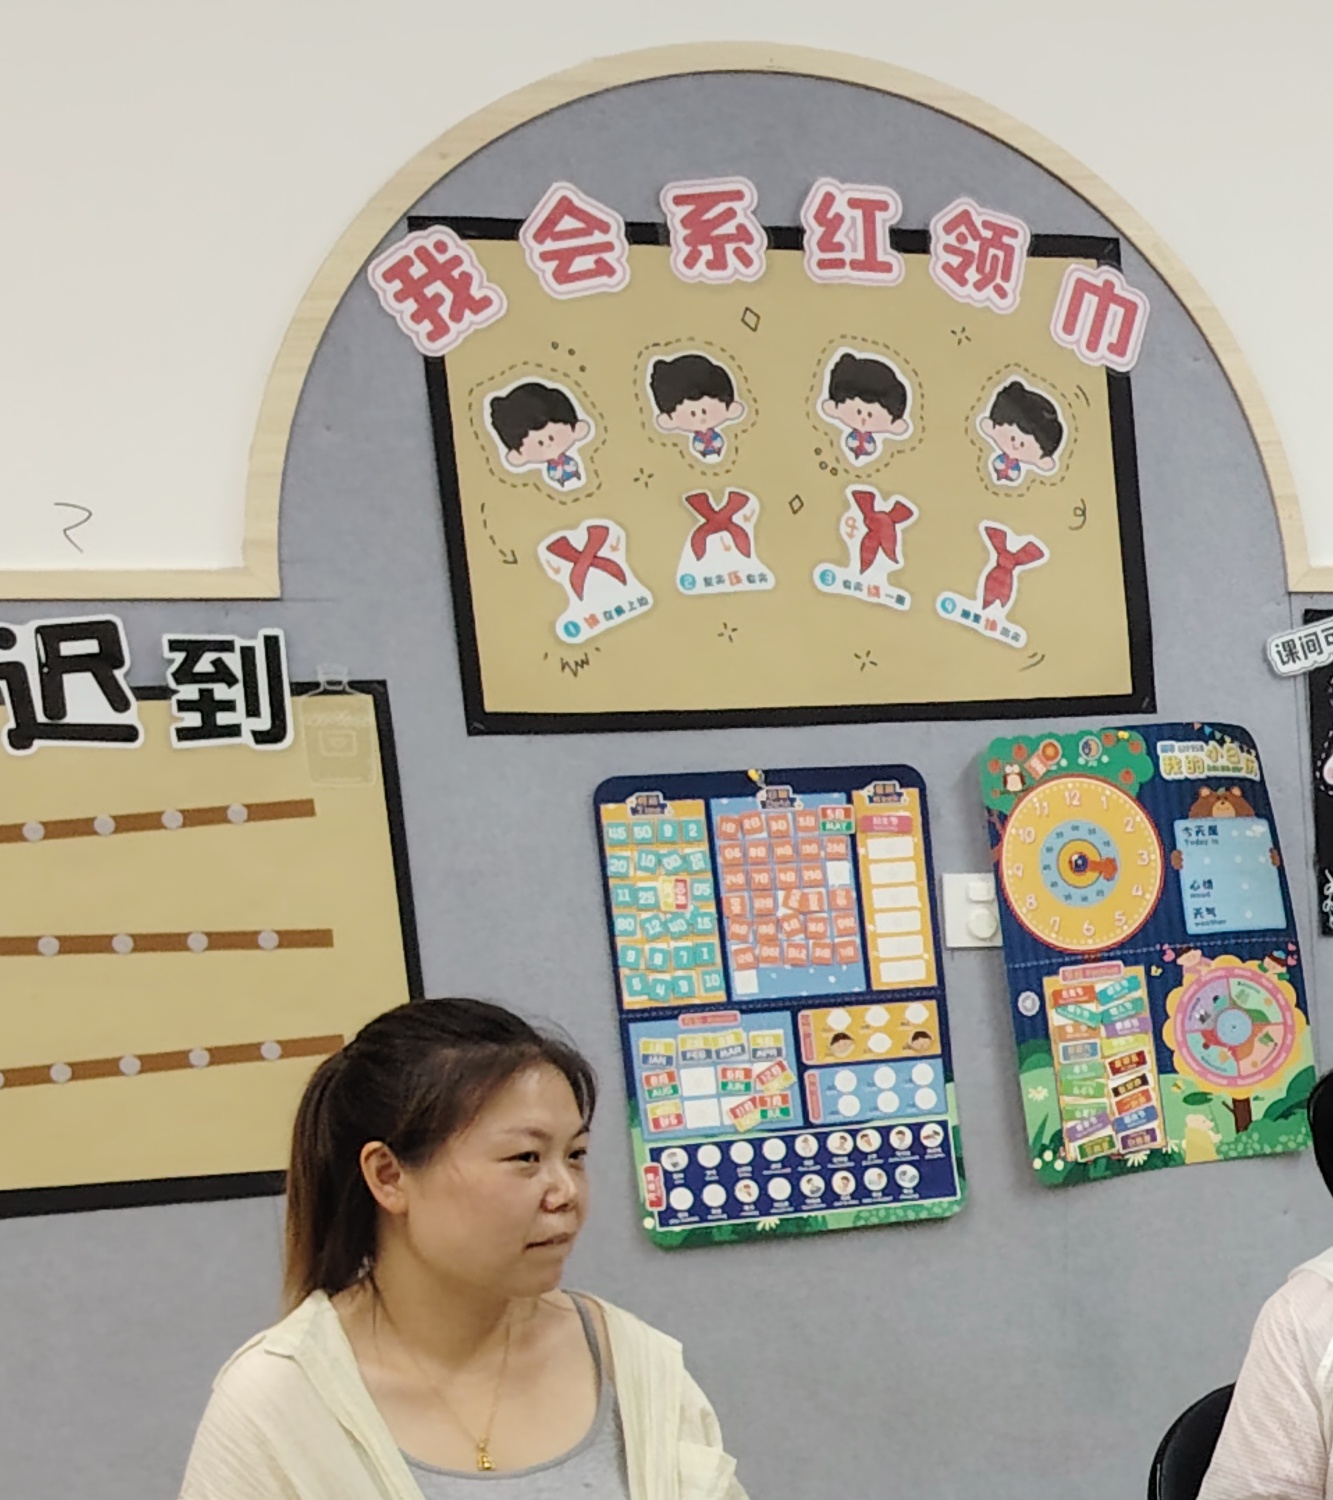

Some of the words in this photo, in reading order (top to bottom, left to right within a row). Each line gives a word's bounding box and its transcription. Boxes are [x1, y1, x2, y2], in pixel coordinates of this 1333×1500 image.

[381, 189, 1142, 363] 我会系红领巾
[0, 620, 286, 750] 迟到
